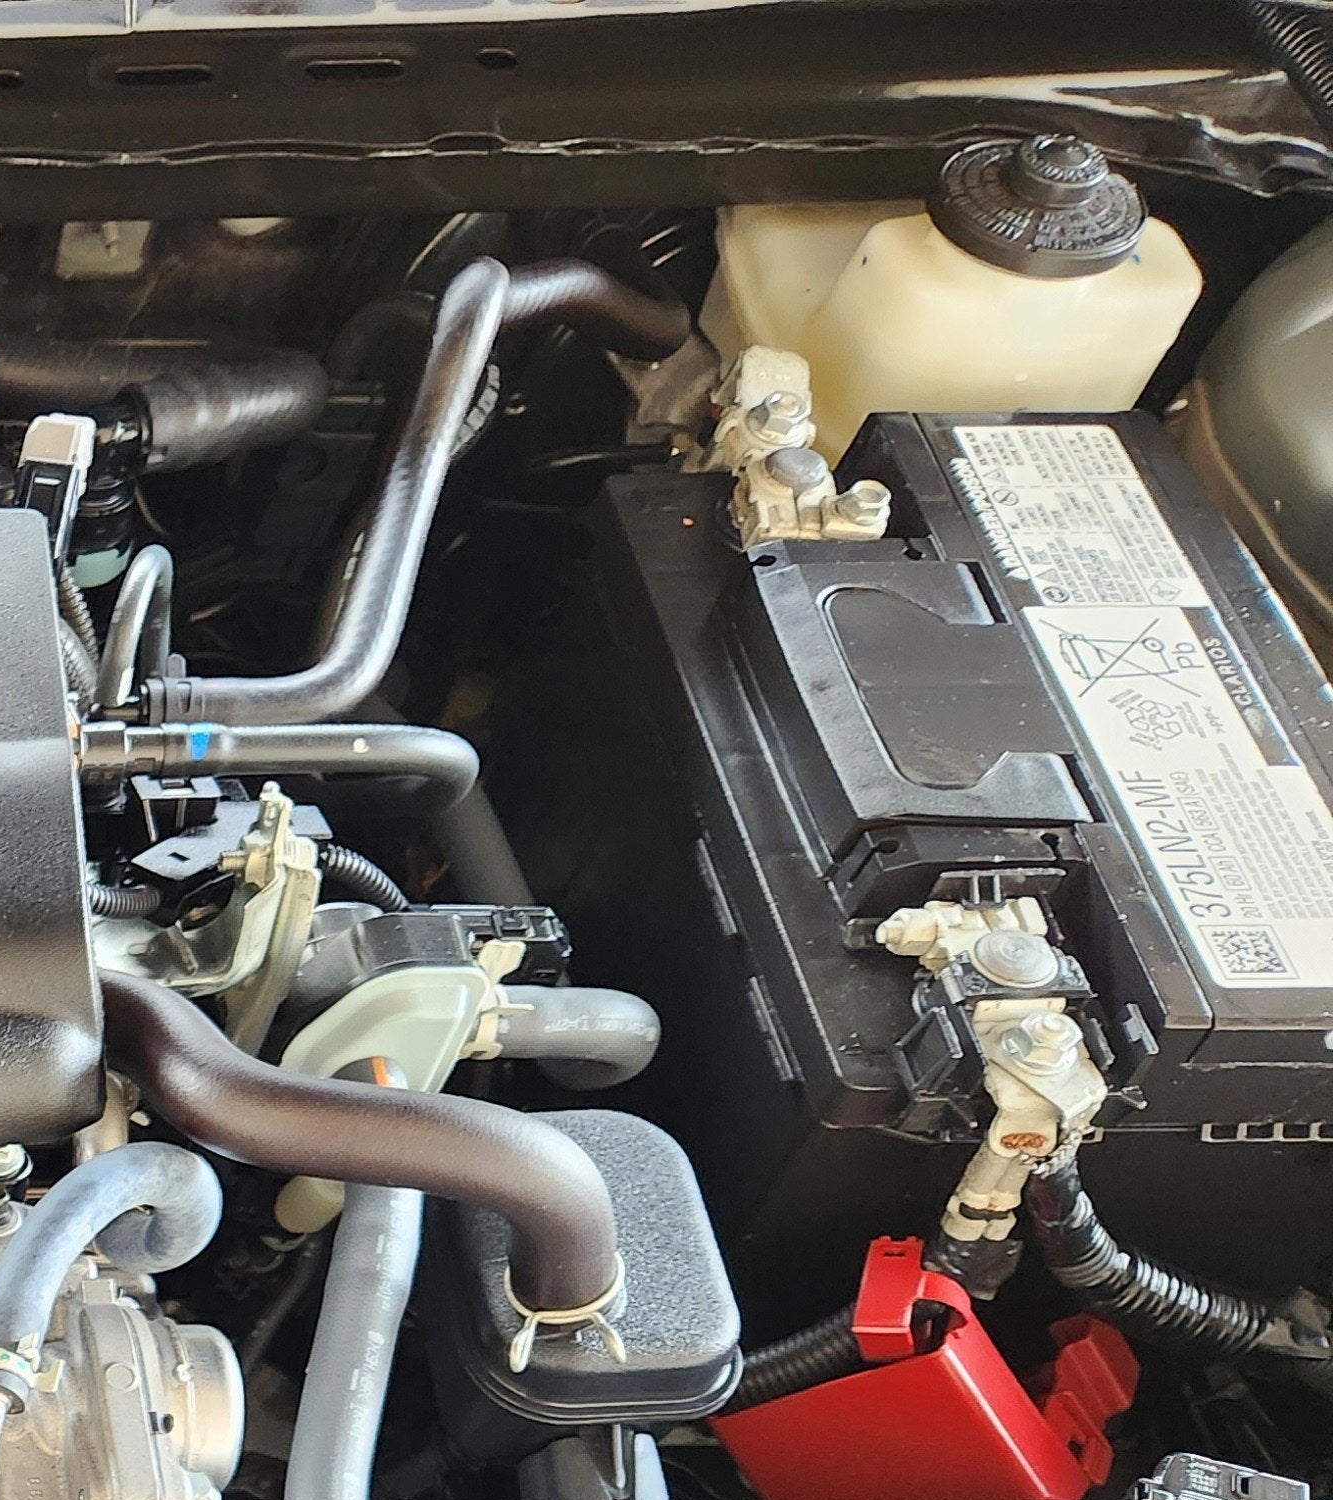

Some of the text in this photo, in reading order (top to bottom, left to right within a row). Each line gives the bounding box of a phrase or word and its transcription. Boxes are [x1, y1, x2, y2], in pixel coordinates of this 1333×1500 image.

[1166, 642, 1205, 668] Pb
[1203, 637, 1253, 705] CLARIOS
[1116, 770, 1234, 917] 375LN2-MF
[1198, 833, 1227, 851] CCA
